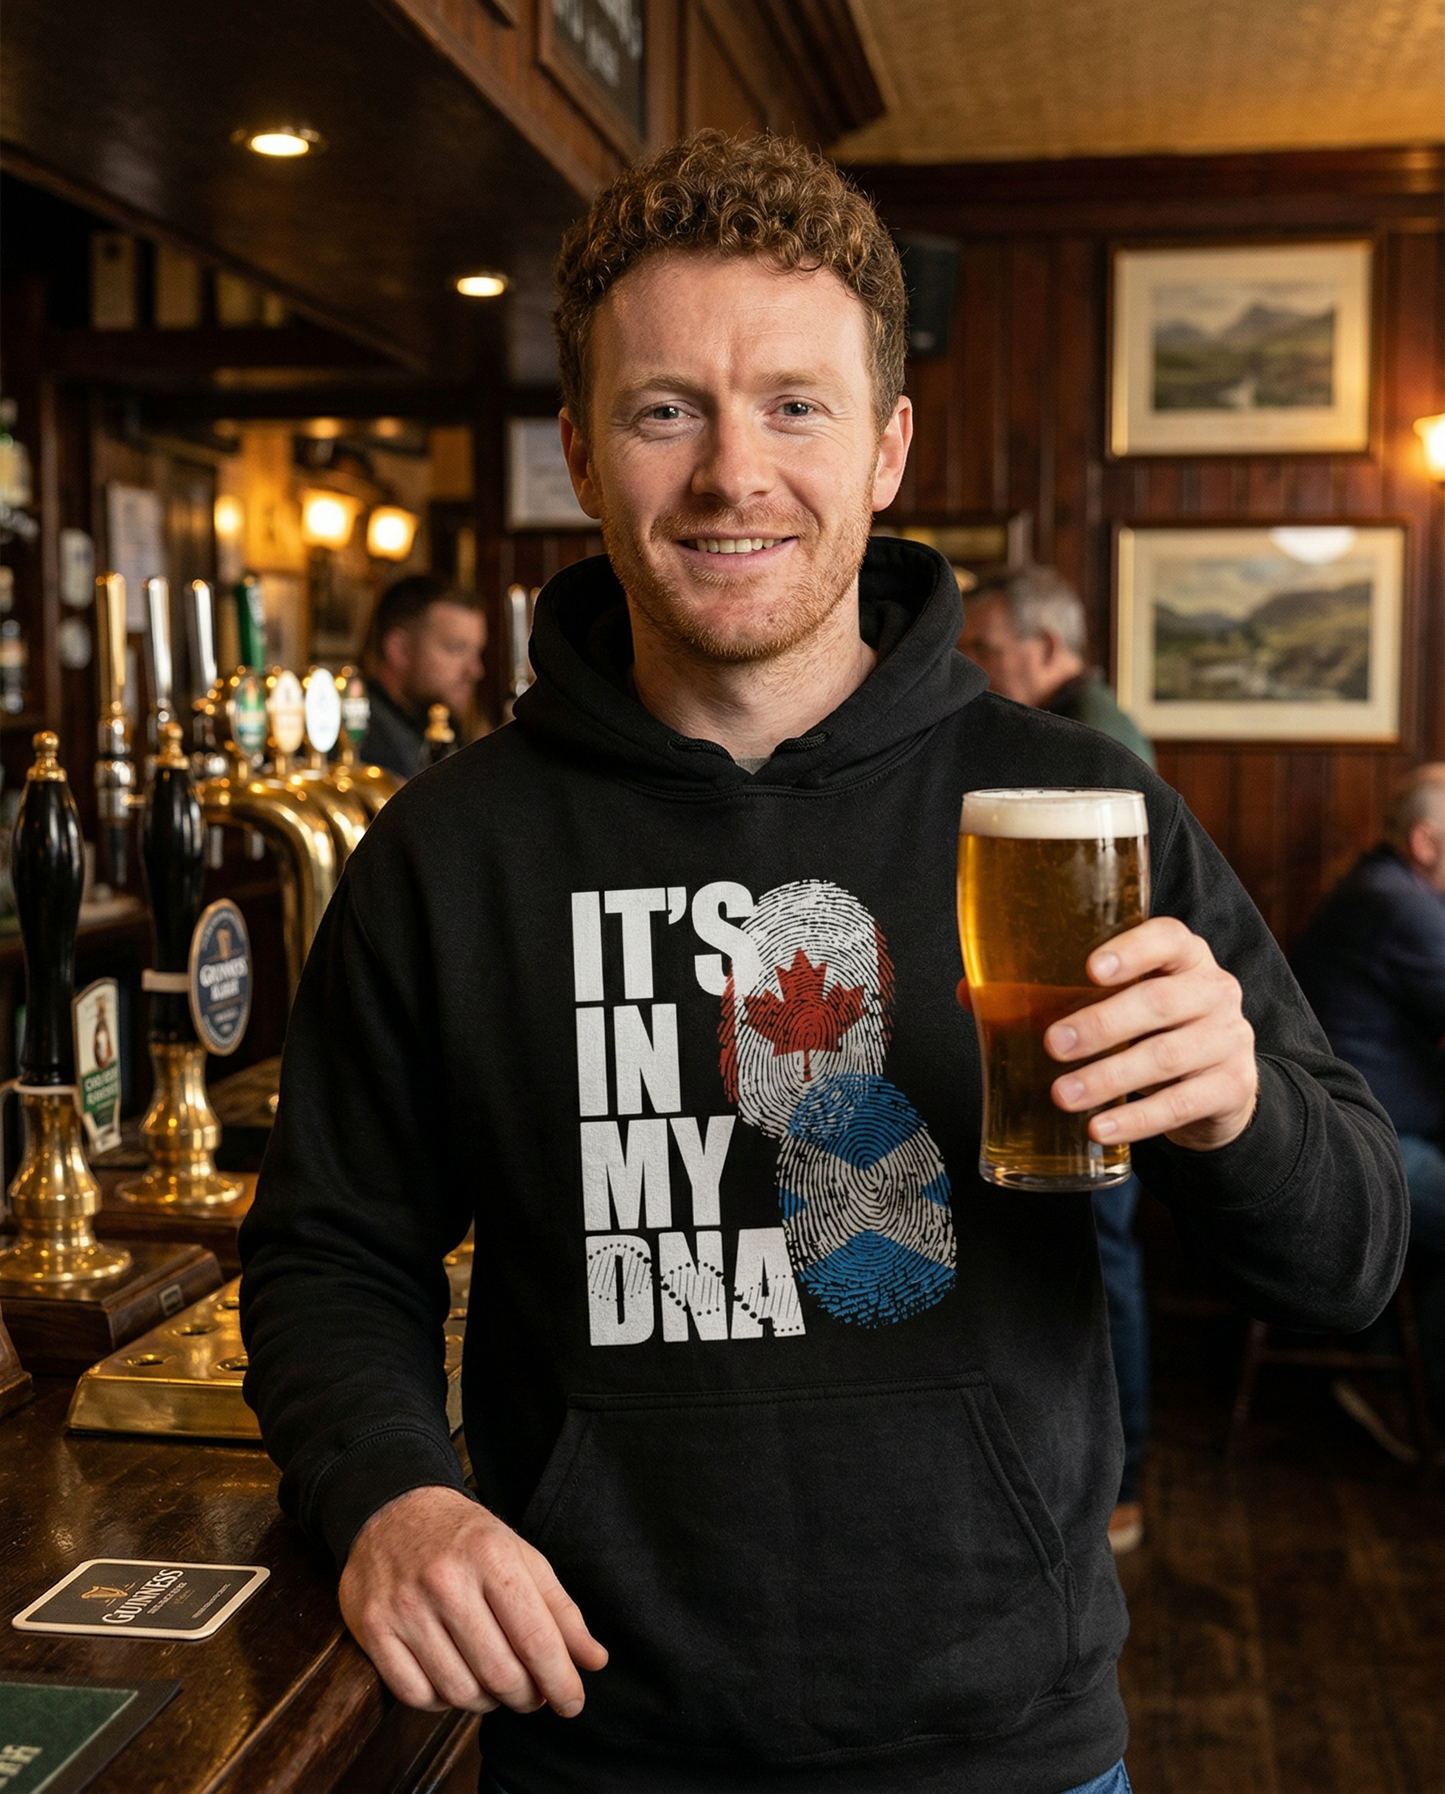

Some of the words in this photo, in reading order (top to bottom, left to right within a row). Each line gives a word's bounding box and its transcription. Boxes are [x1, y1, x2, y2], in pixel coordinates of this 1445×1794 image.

[571, 881, 763, 1002] IT'S
[575, 1003, 682, 1117] IN
[580, 1115, 736, 1231] MY
[585, 1227, 806, 1346] DNA
[101, 1568, 184, 1624] GUINNESS
